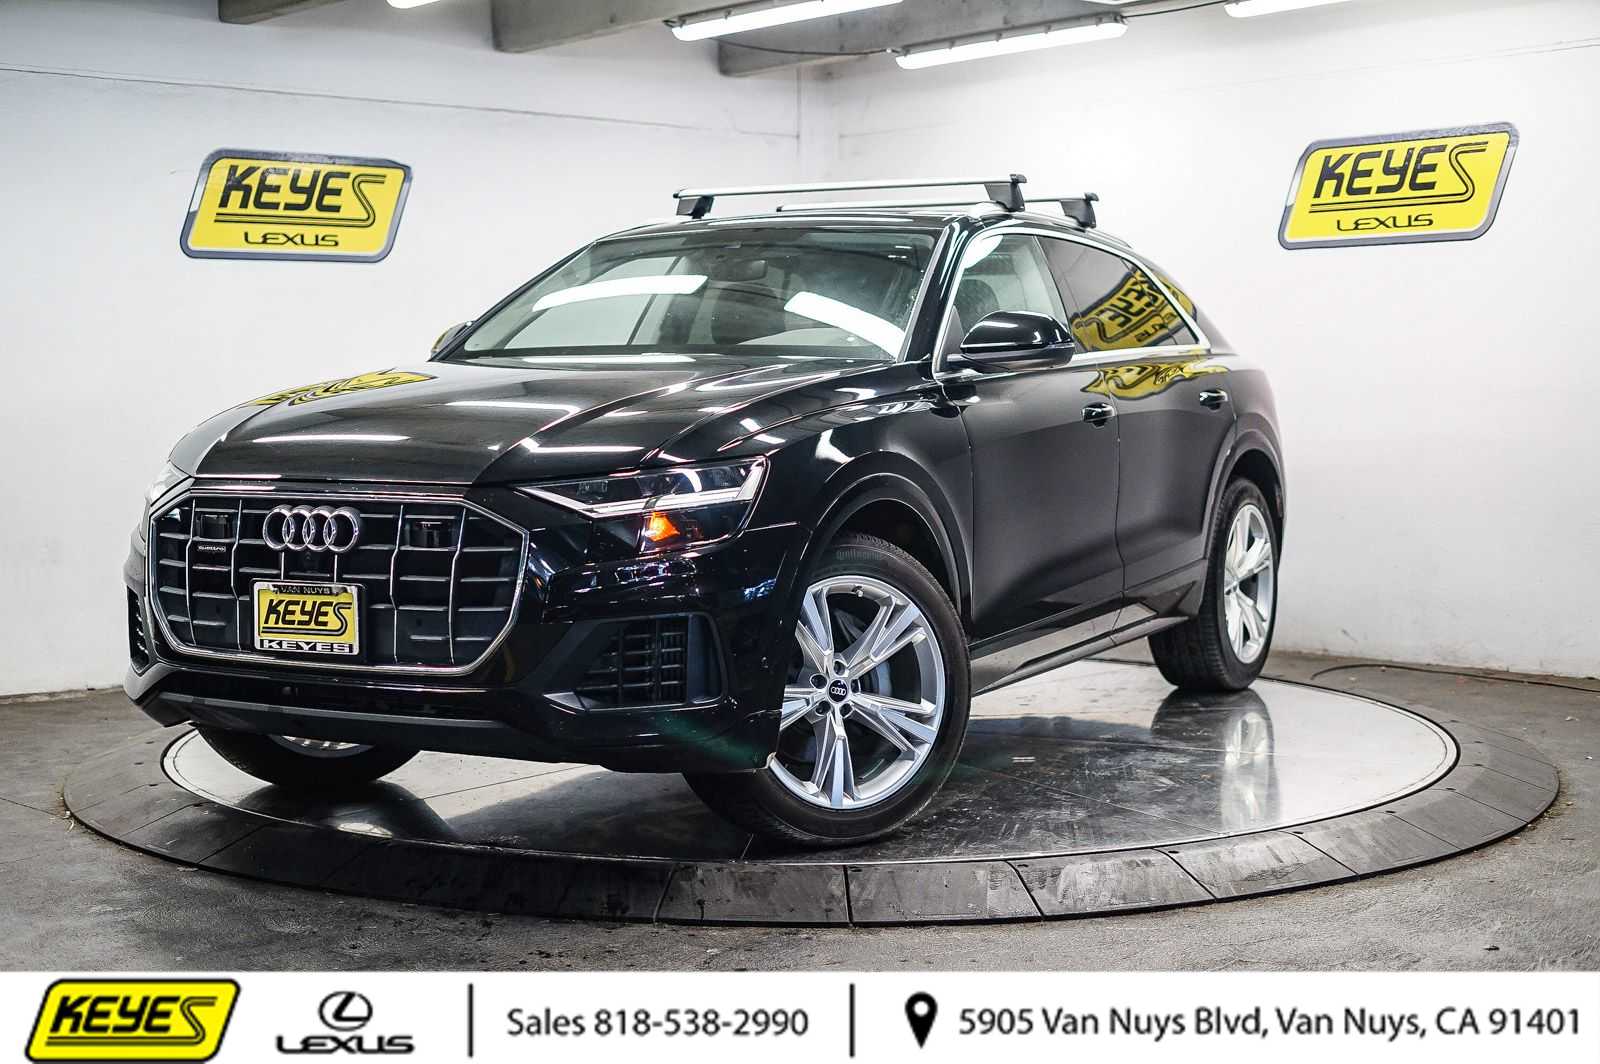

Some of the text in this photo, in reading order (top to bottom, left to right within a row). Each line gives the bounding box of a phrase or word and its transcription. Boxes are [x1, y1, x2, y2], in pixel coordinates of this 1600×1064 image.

[1309, 141, 1489, 213] KEYES
[214, 164, 386, 228] KEYES
[1336, 213, 1434, 231] LEXUS
[243, 231, 339, 247] LEXUS
[281, 585, 330, 595] VAN NUYS
[261, 599, 352, 636] KEYES
[263, 639, 350, 653] KEYES
